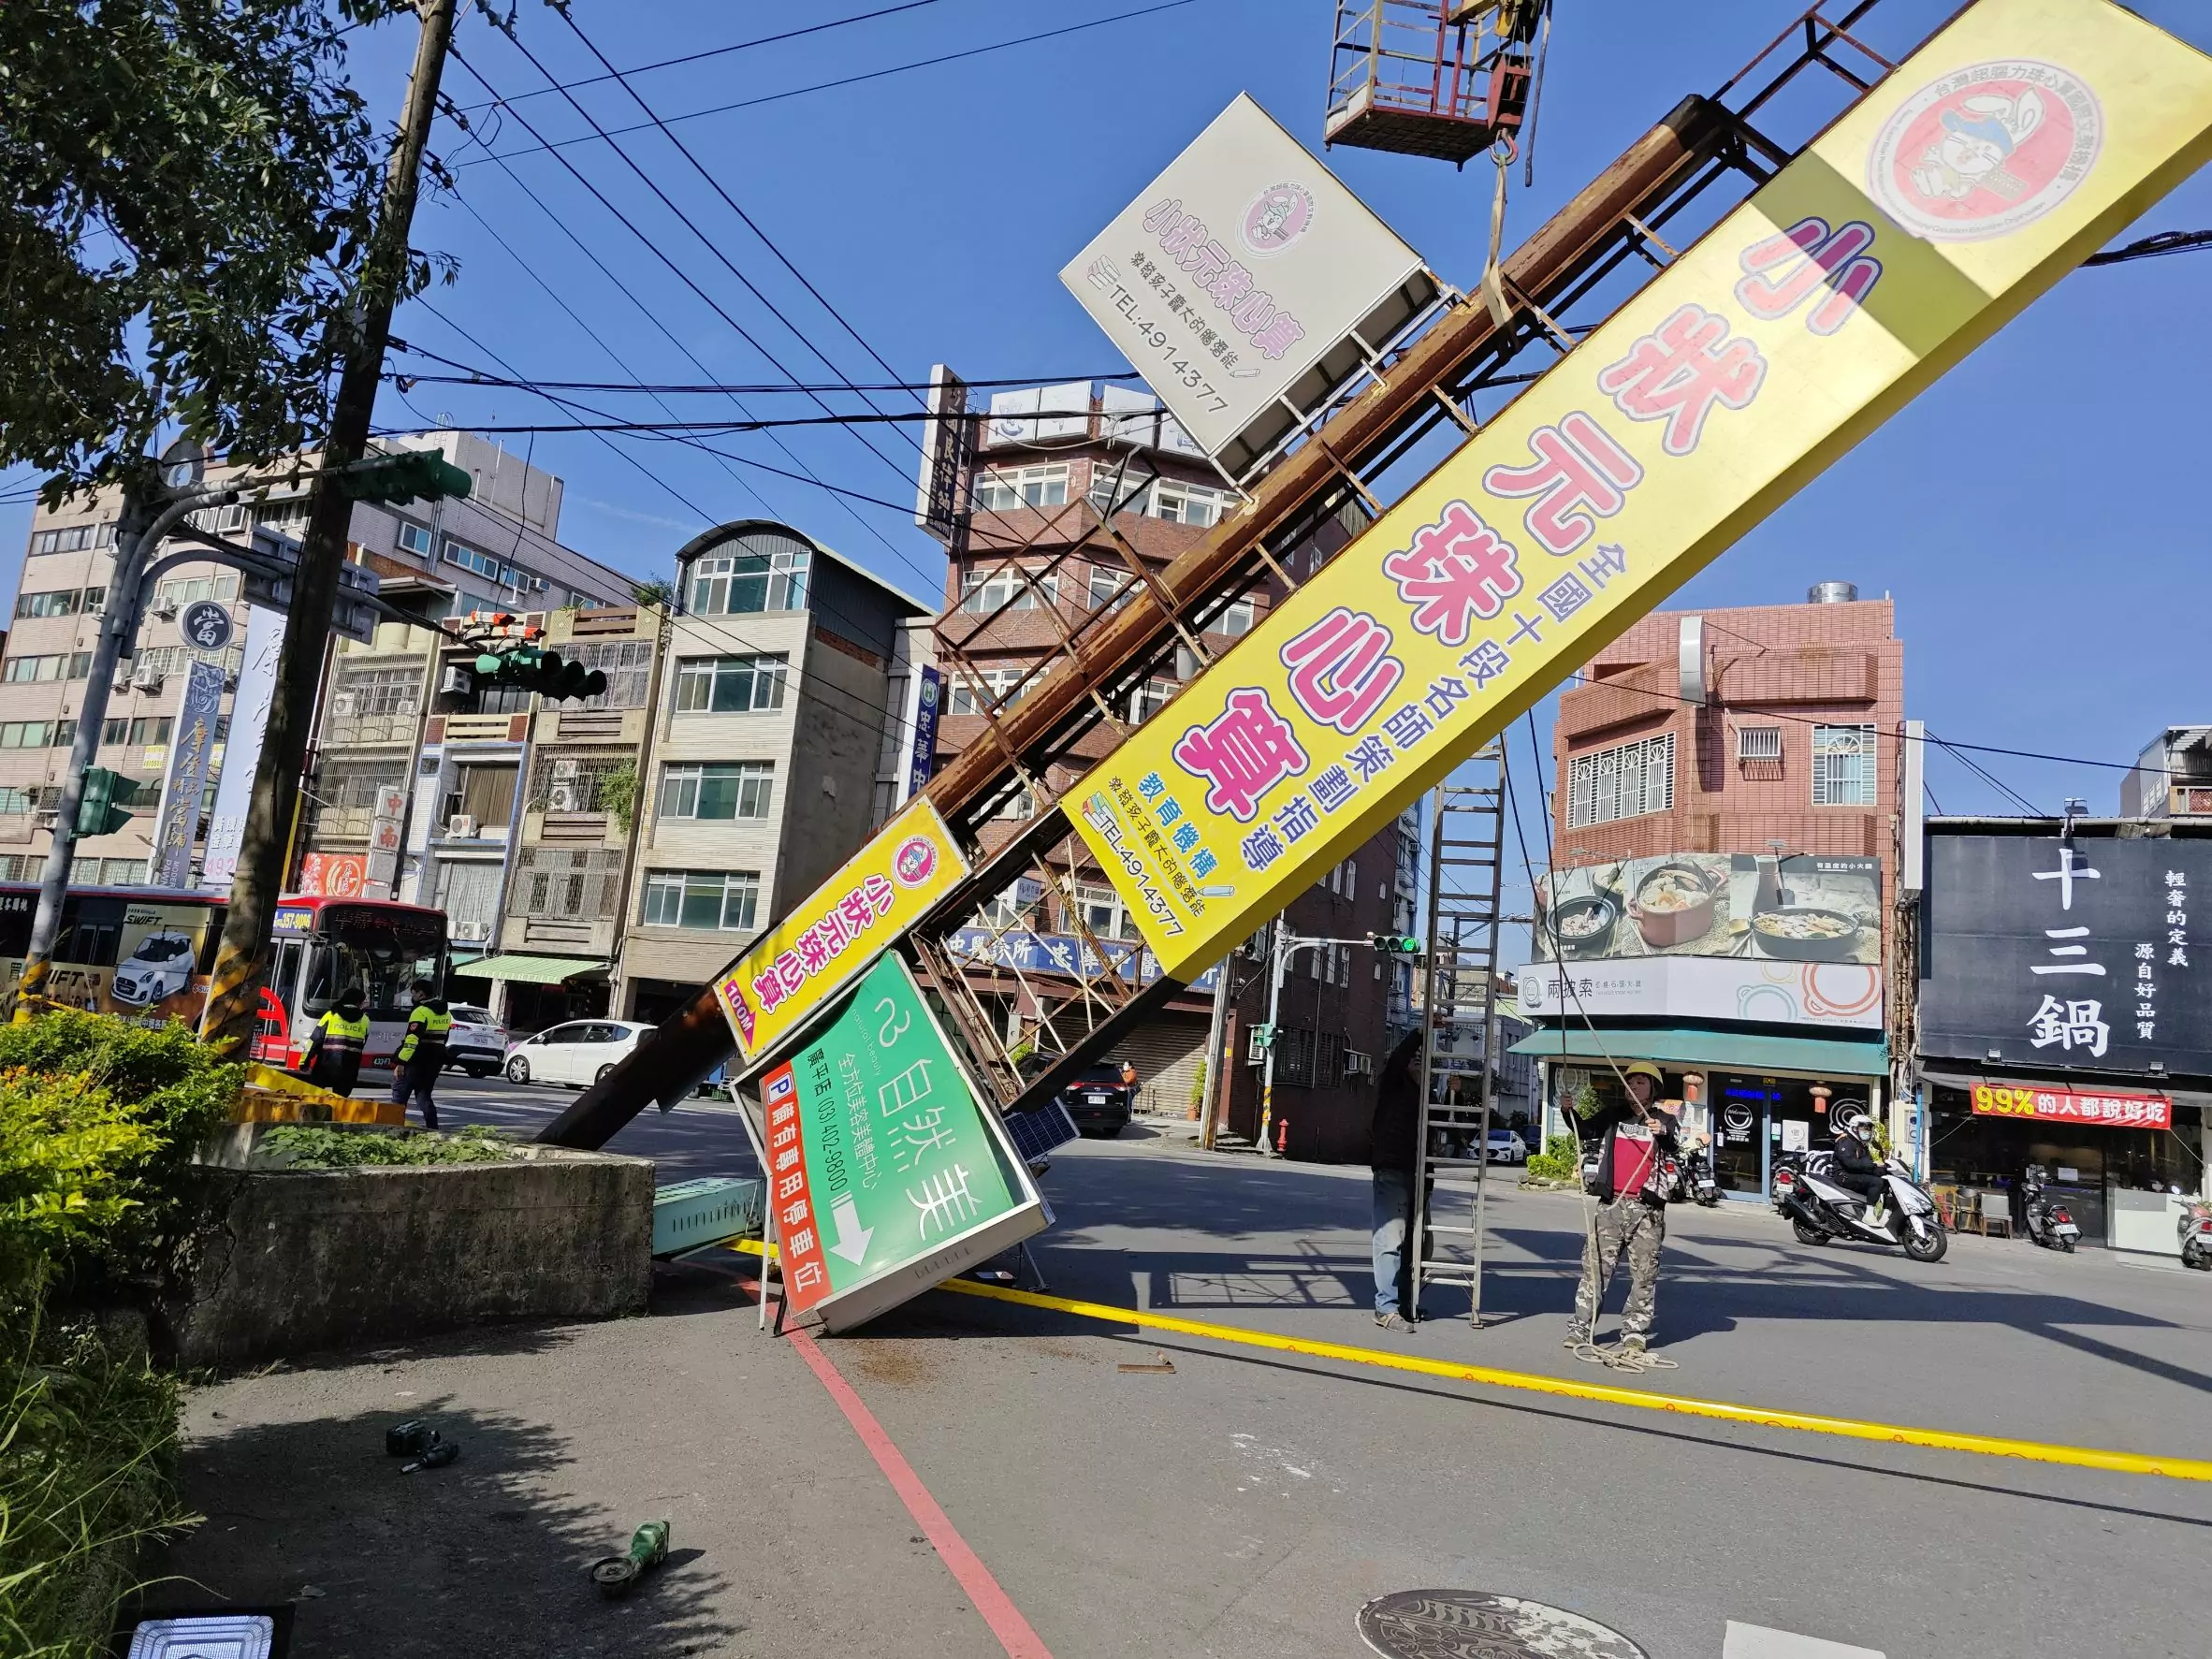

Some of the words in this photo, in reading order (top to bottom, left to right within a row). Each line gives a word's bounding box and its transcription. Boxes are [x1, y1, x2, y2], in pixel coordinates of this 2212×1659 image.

[1142, 198, 1306, 360] 小狀元珠心算
[1109, 284, 1228, 413] TEL:4914377
[1172, 215, 1883, 823] 小狀元珠心算
[1242, 543, 1628, 871] 全國十段名師策劃指導
[1100, 815, 1185, 938] TEL:4914377
[1138, 772, 1217, 879] 教育機構
[750, 873, 896, 1015] 小狀元珠心算
[2026, 848, 2110, 1058] 十三鍋
[2163, 869, 2189, 968] 輕奢的定義
[727, 985, 752, 1032] 100M
[1548, 978, 1593, 999] 兩披索
[2134, 942, 2157, 1041] 源自好品質
[817, 1097, 848, 1192] (03)402-9800
[838, 1053, 884, 1190] 全方位美容美體中心
[879, 1057, 983, 1242] 自然美
[1975, 1085, 2166, 1123] 99%的人都說好吃
[772, 1101, 824, 1293] 備有專用停車位
